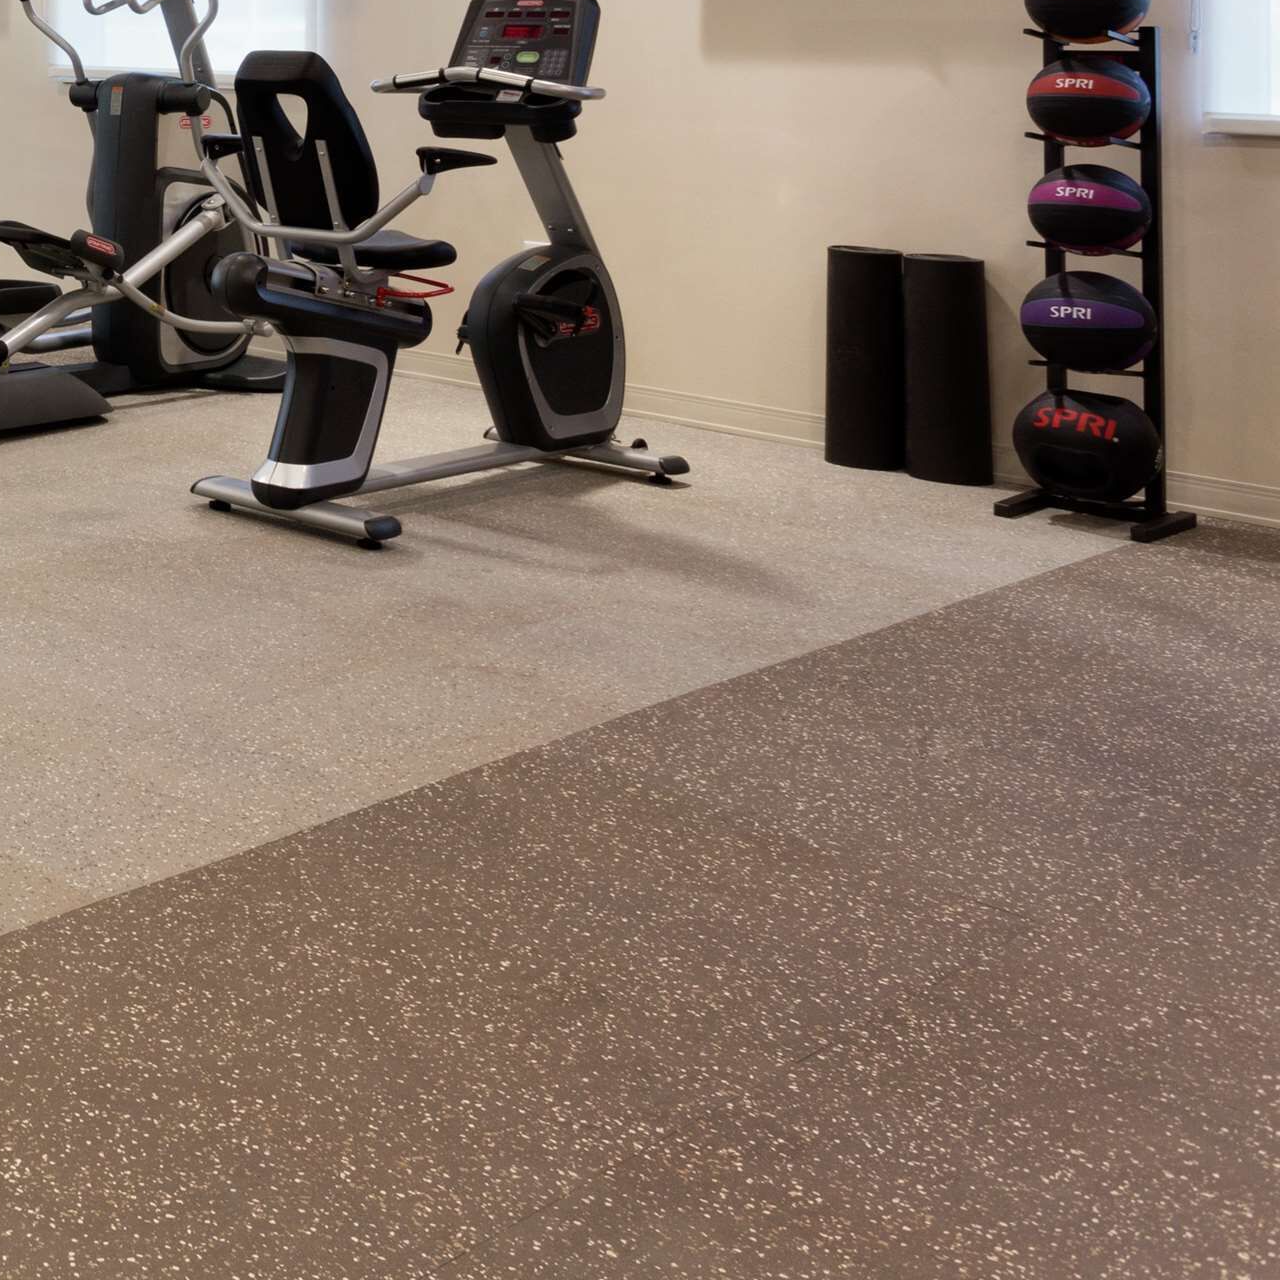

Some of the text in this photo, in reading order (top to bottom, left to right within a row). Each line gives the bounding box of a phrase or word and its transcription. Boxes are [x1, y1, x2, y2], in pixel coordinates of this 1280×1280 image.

[1055, 78, 1093, 90] SPRI
[1056, 186, 1094, 199] SPRI
[1050, 306, 1091, 320] SPRI
[1033, 408, 1117, 442] SPRI
